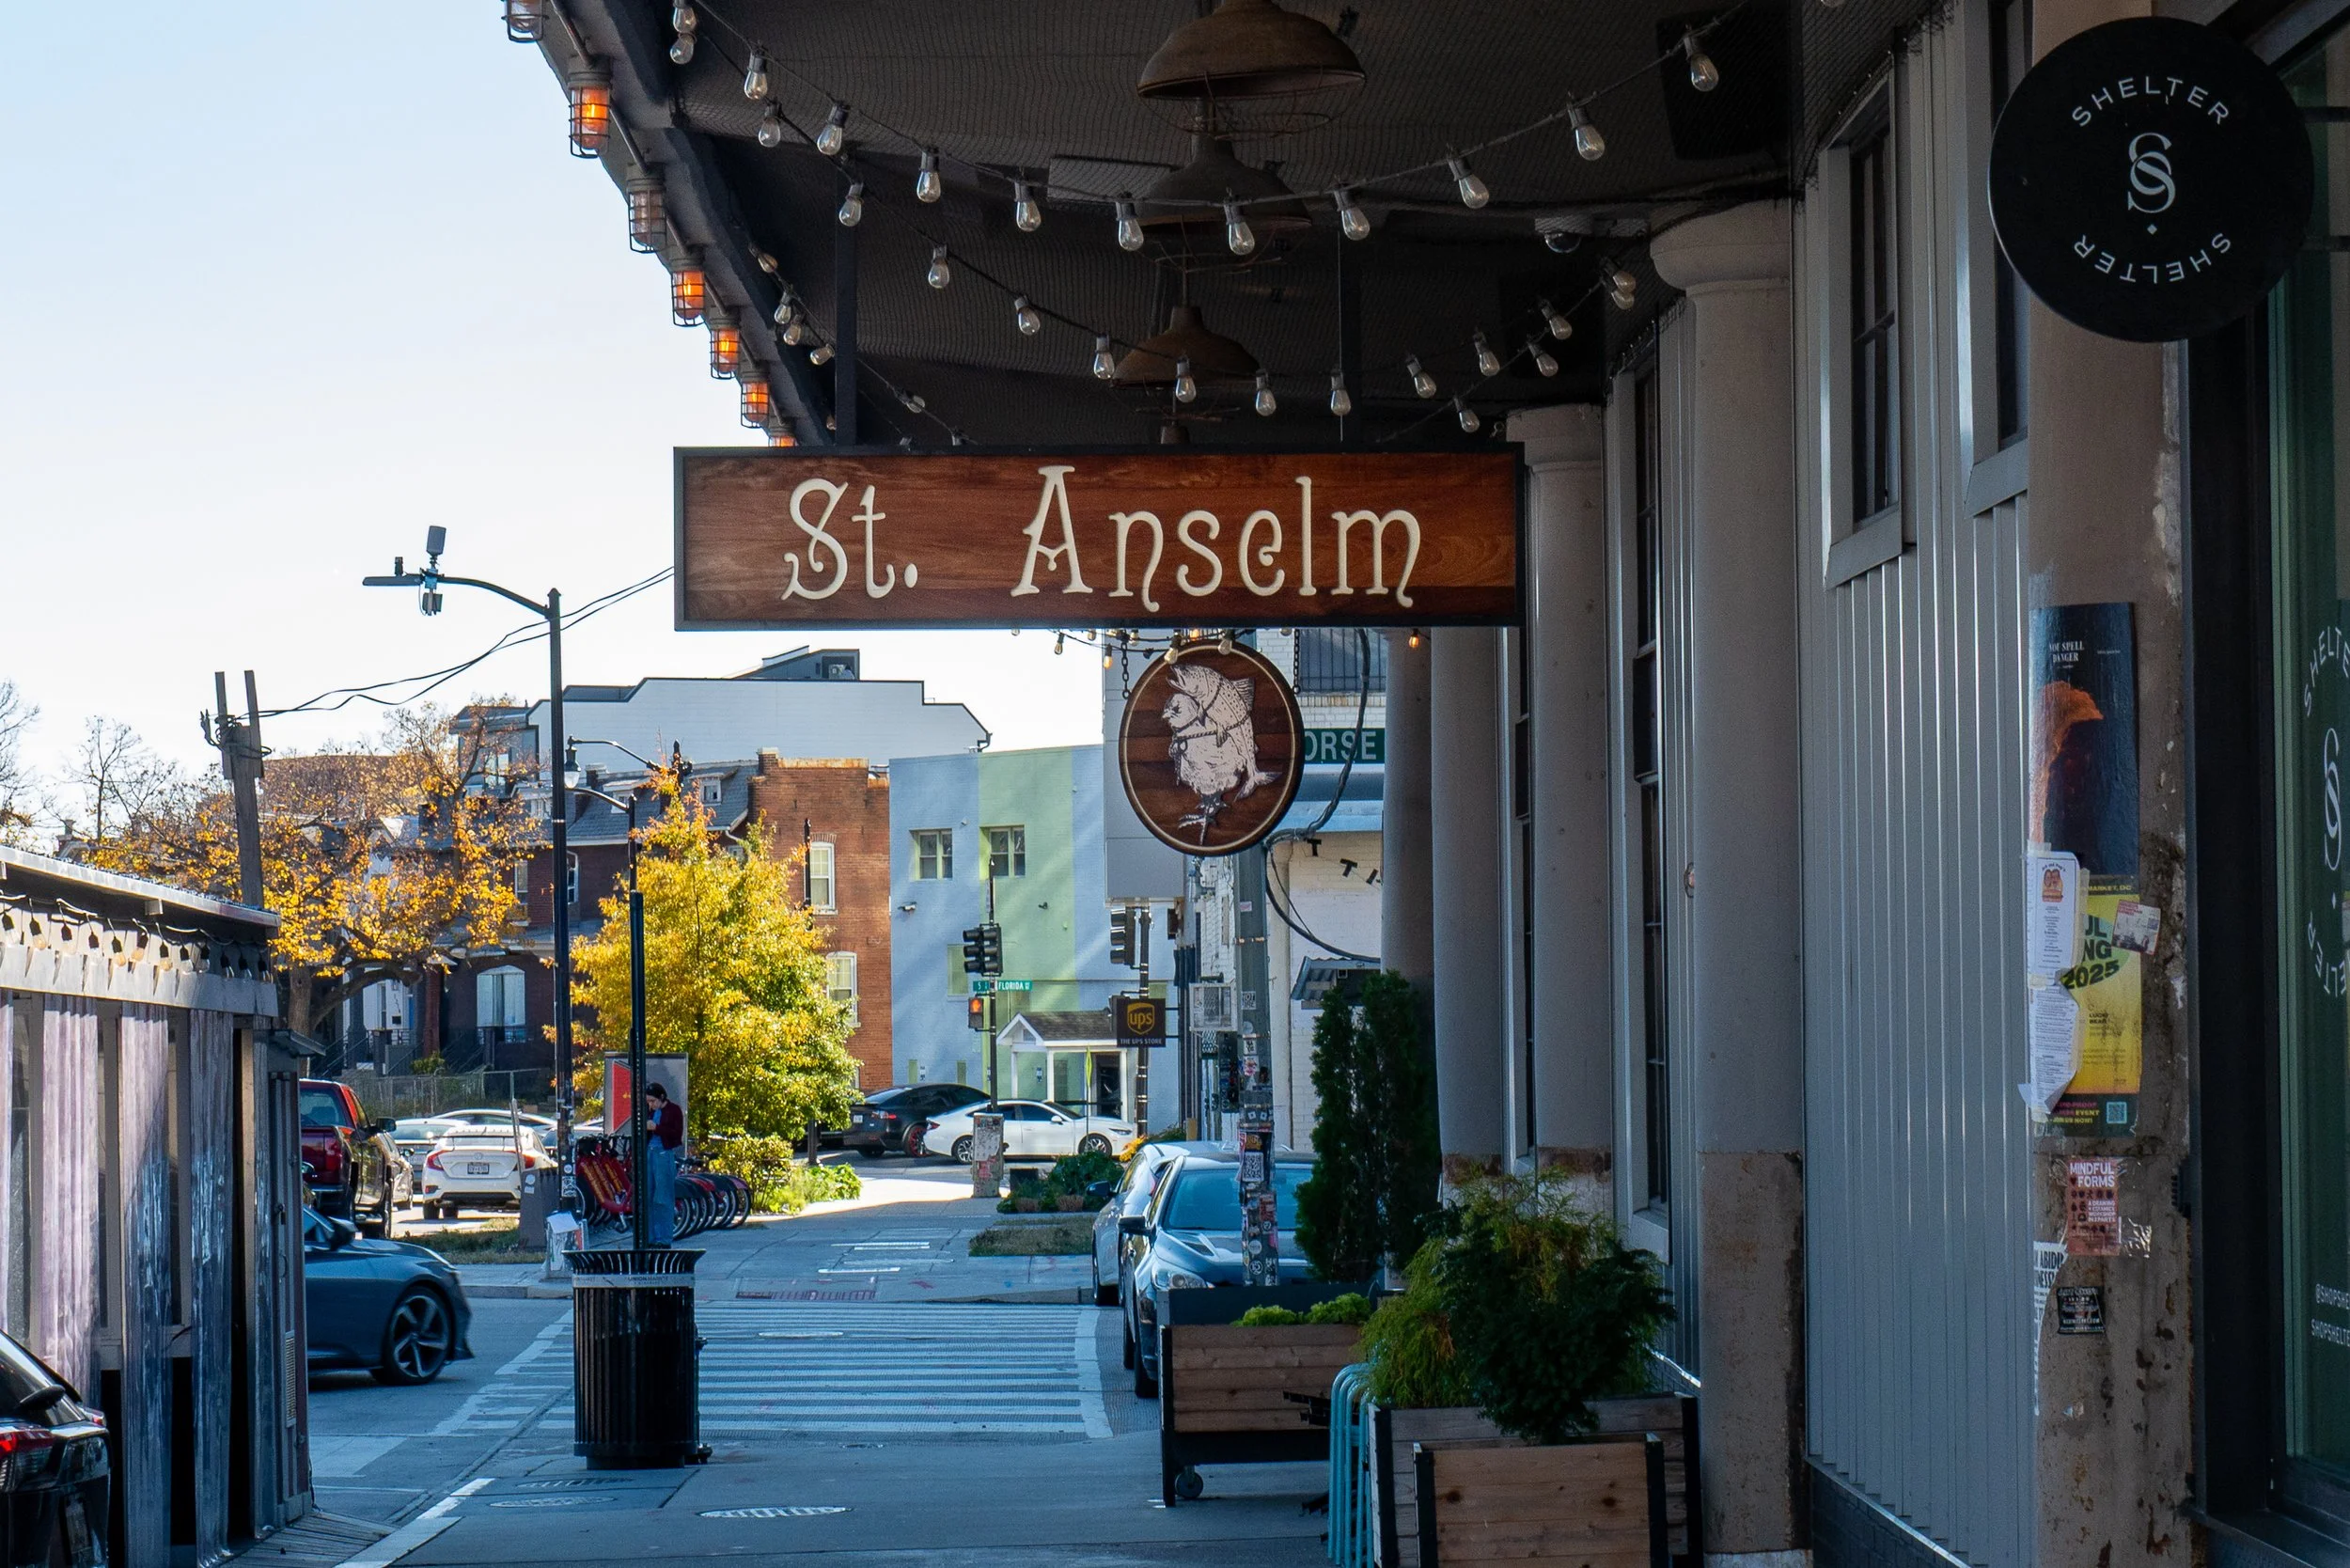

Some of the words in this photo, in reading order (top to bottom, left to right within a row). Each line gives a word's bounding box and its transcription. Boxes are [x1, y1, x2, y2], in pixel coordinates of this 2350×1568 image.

[2072, 75, 2229, 127] SHELTER
[2074, 232, 2232, 284] SHELTER
[780, 477, 918, 602] St.
[1010, 464, 1422, 613] Anselm
[2061, 640, 2085, 652] SPELL
[2052, 651, 2079, 663] DANGER
[2061, 960, 2120, 990] 2025
[998, 981, 1024, 990] FLORIDA
[1130, 1012, 1152, 1029] ups
[2070, 1162, 2114, 1174] MINDFUL
[2077, 1175, 2115, 1187] FORMS
